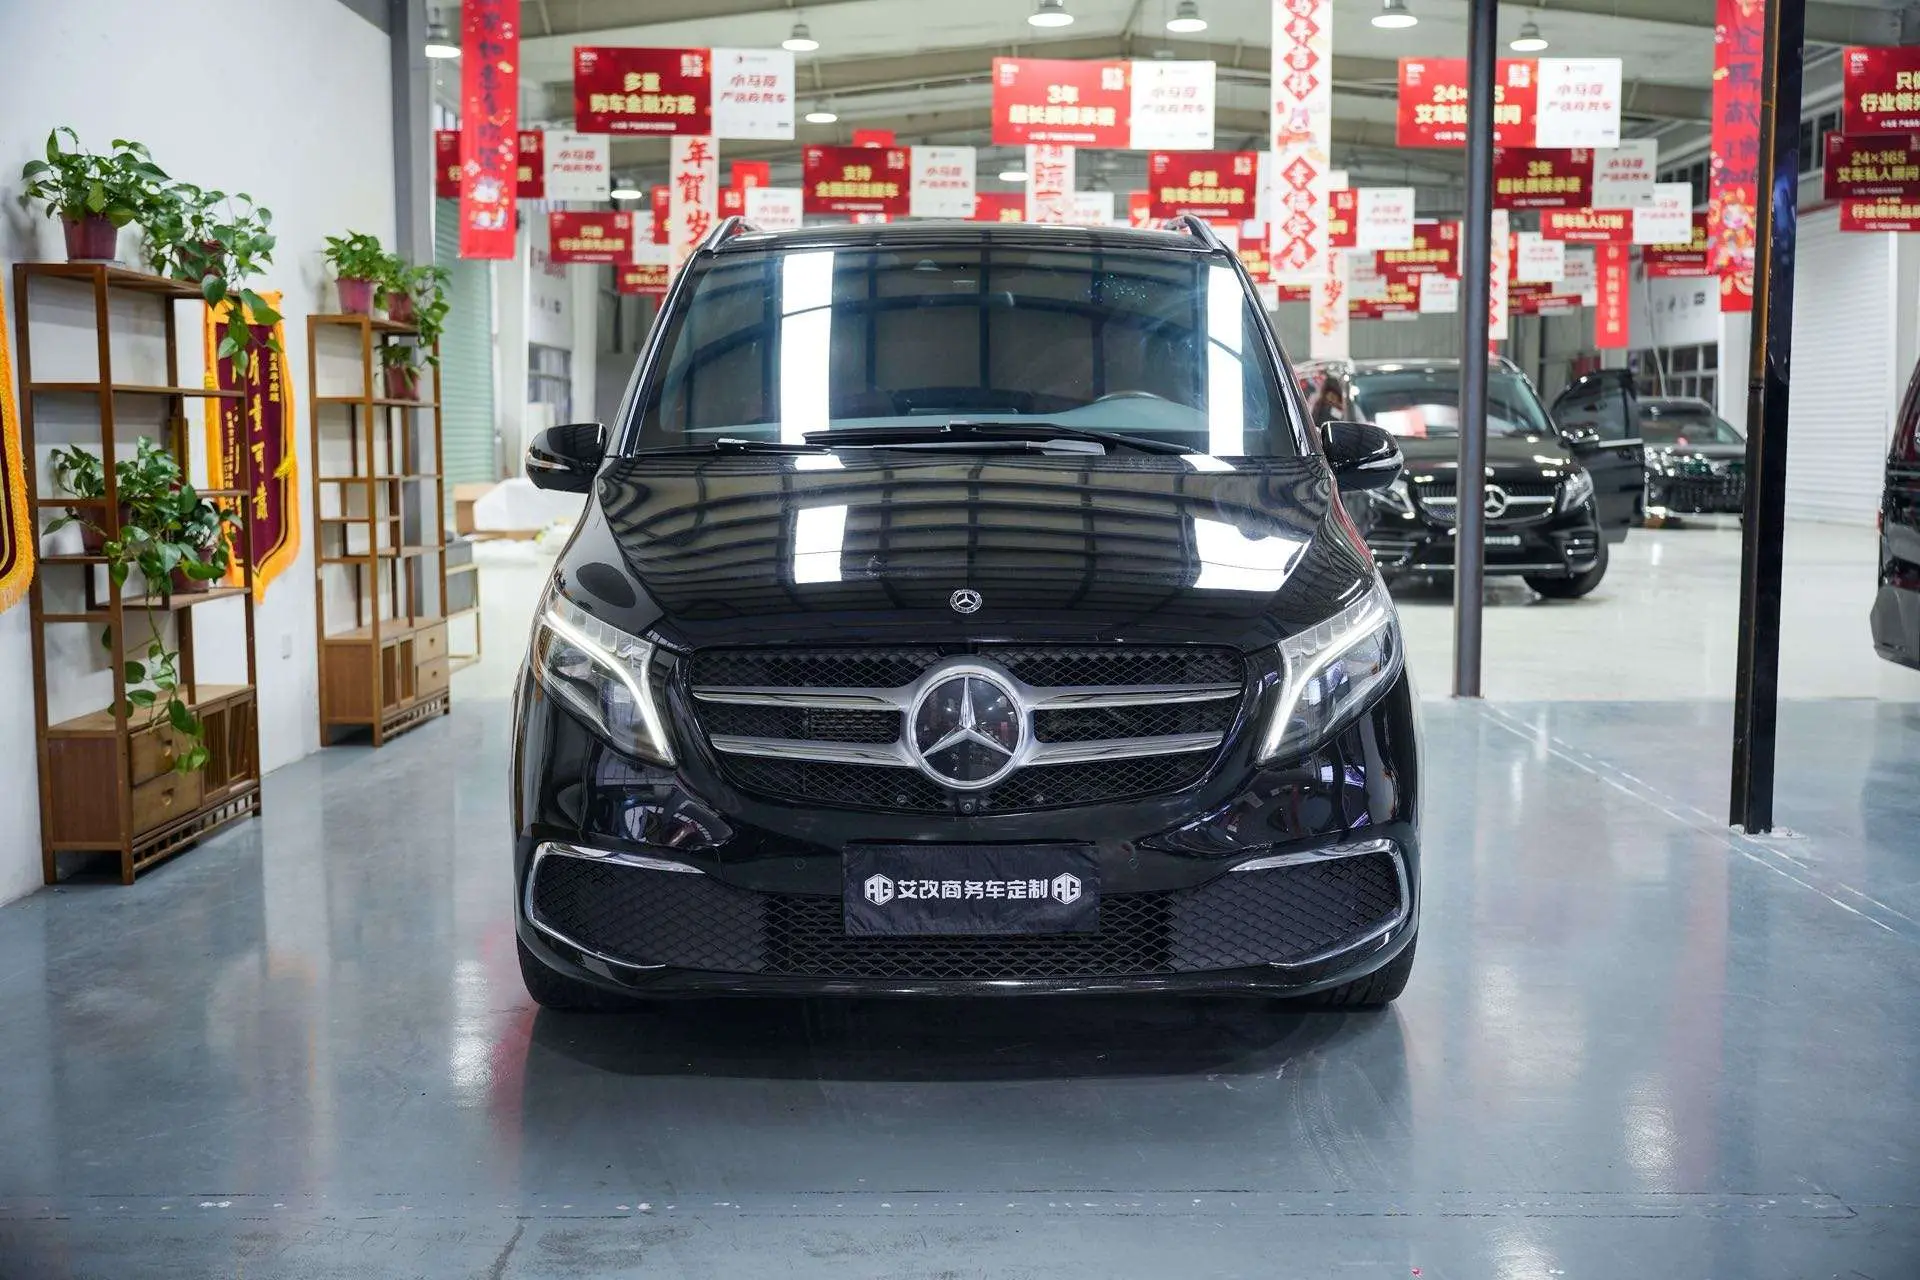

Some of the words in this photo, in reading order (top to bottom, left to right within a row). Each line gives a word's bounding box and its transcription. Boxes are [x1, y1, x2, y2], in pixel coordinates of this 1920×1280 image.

[1433, 84, 1505, 103] 24×5
[897, 879, 1048, 900] 艾改商务车定制
